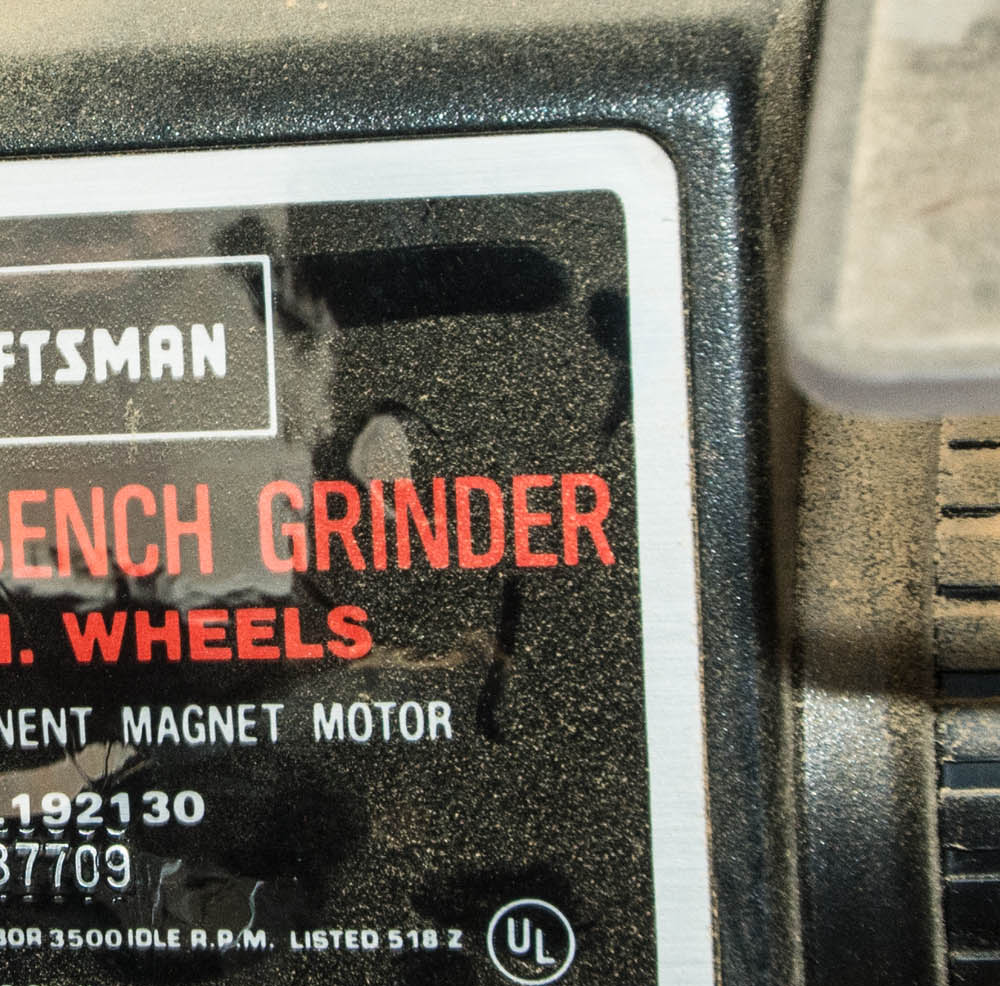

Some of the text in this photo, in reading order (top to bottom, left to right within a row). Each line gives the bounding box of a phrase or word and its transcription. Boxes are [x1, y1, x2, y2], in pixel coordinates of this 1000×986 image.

[257, 473, 616, 572] GRINDER
[61, 605, 374, 664] WHEELS
[122, 703, 285, 746] MAGNET
[312, 700, 453, 742] MOTOR
[49, 929, 122, 950] 3500
[127, 928, 181, 949] IDLE
[190, 928, 274, 950] R.P.M.
[291, 929, 379, 950] LISTED
[506, 916, 555, 967] UL
